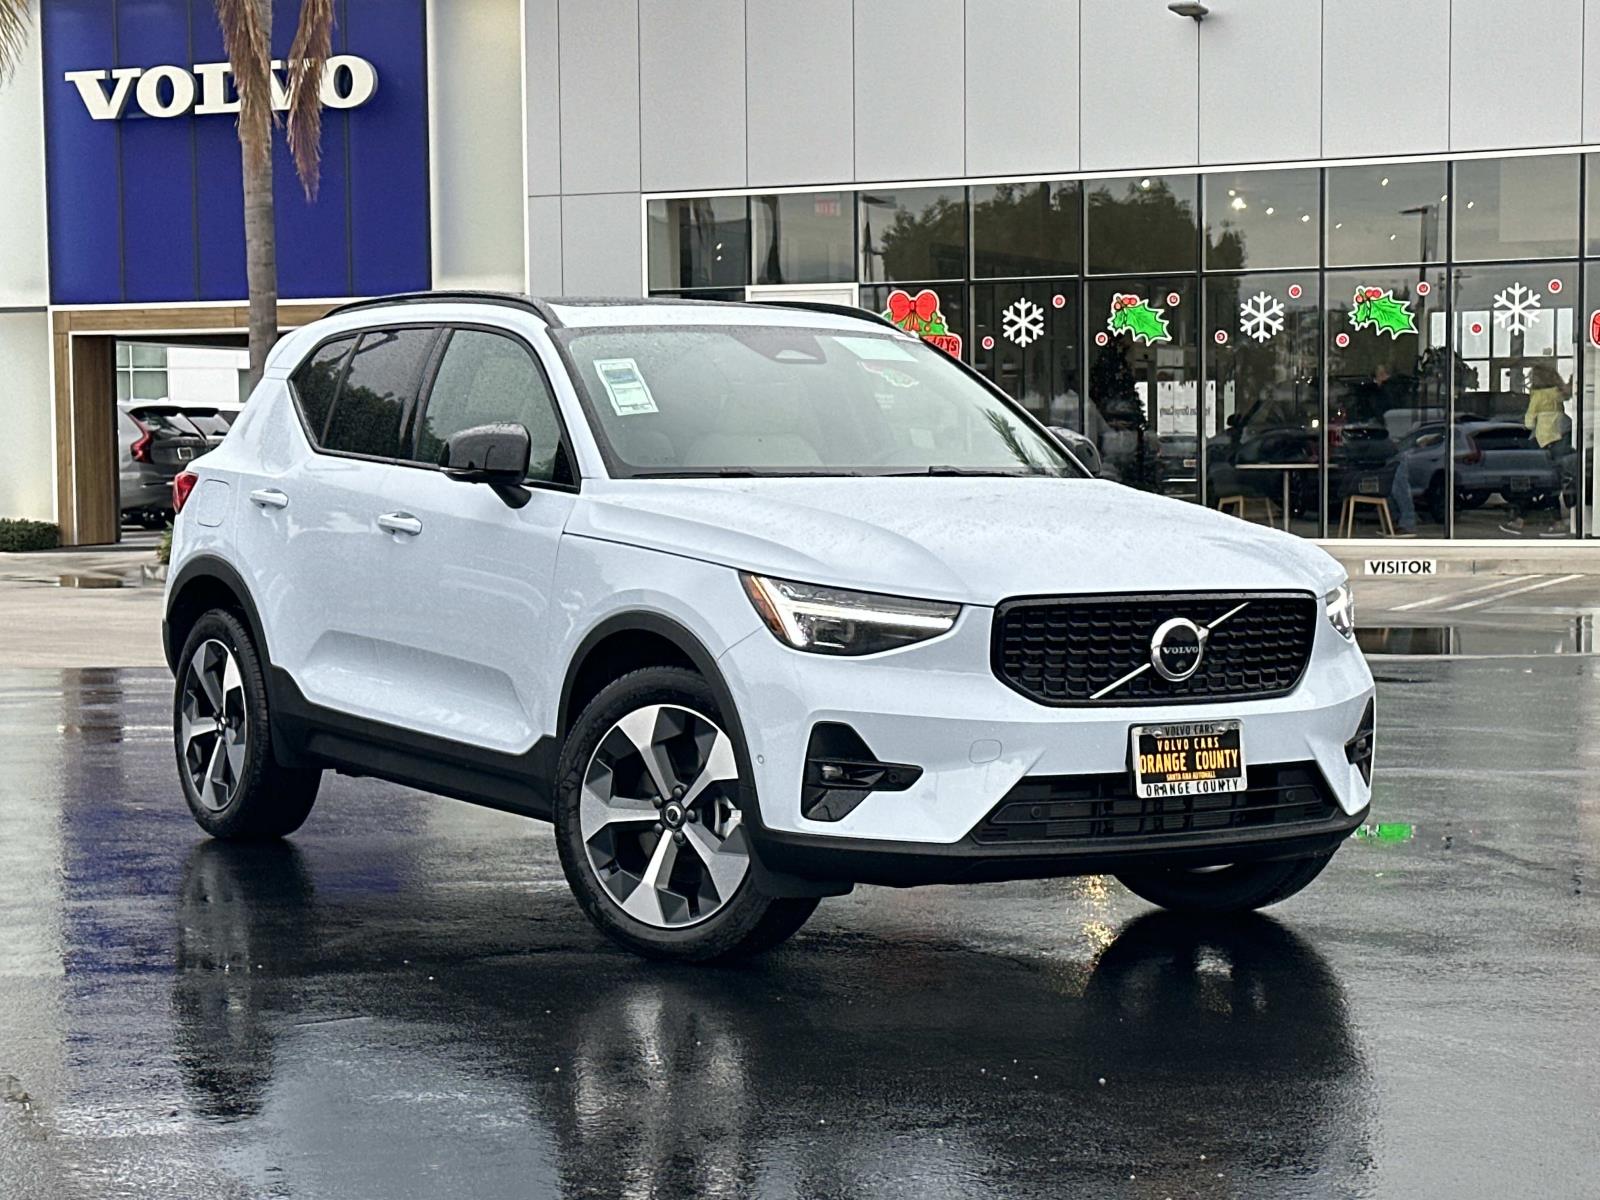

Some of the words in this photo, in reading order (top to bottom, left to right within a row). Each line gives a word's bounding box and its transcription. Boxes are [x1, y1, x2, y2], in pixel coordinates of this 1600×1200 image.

[1370, 560, 1431, 574] VISITOR
[1162, 646, 1198, 654] VOLVO
[1165, 725, 1190, 736] VOLVO
[1194, 723, 1215, 735] CARS
[1157, 739, 1189, 752] VOLVO
[1194, 737, 1219, 749] CARS
[1139, 752, 1187, 774] ORANGE
[1195, 749, 1238, 770] COUNTY
[1146, 782, 1191, 797] ORANGE
[1196, 779, 1238, 793] COUNTY
